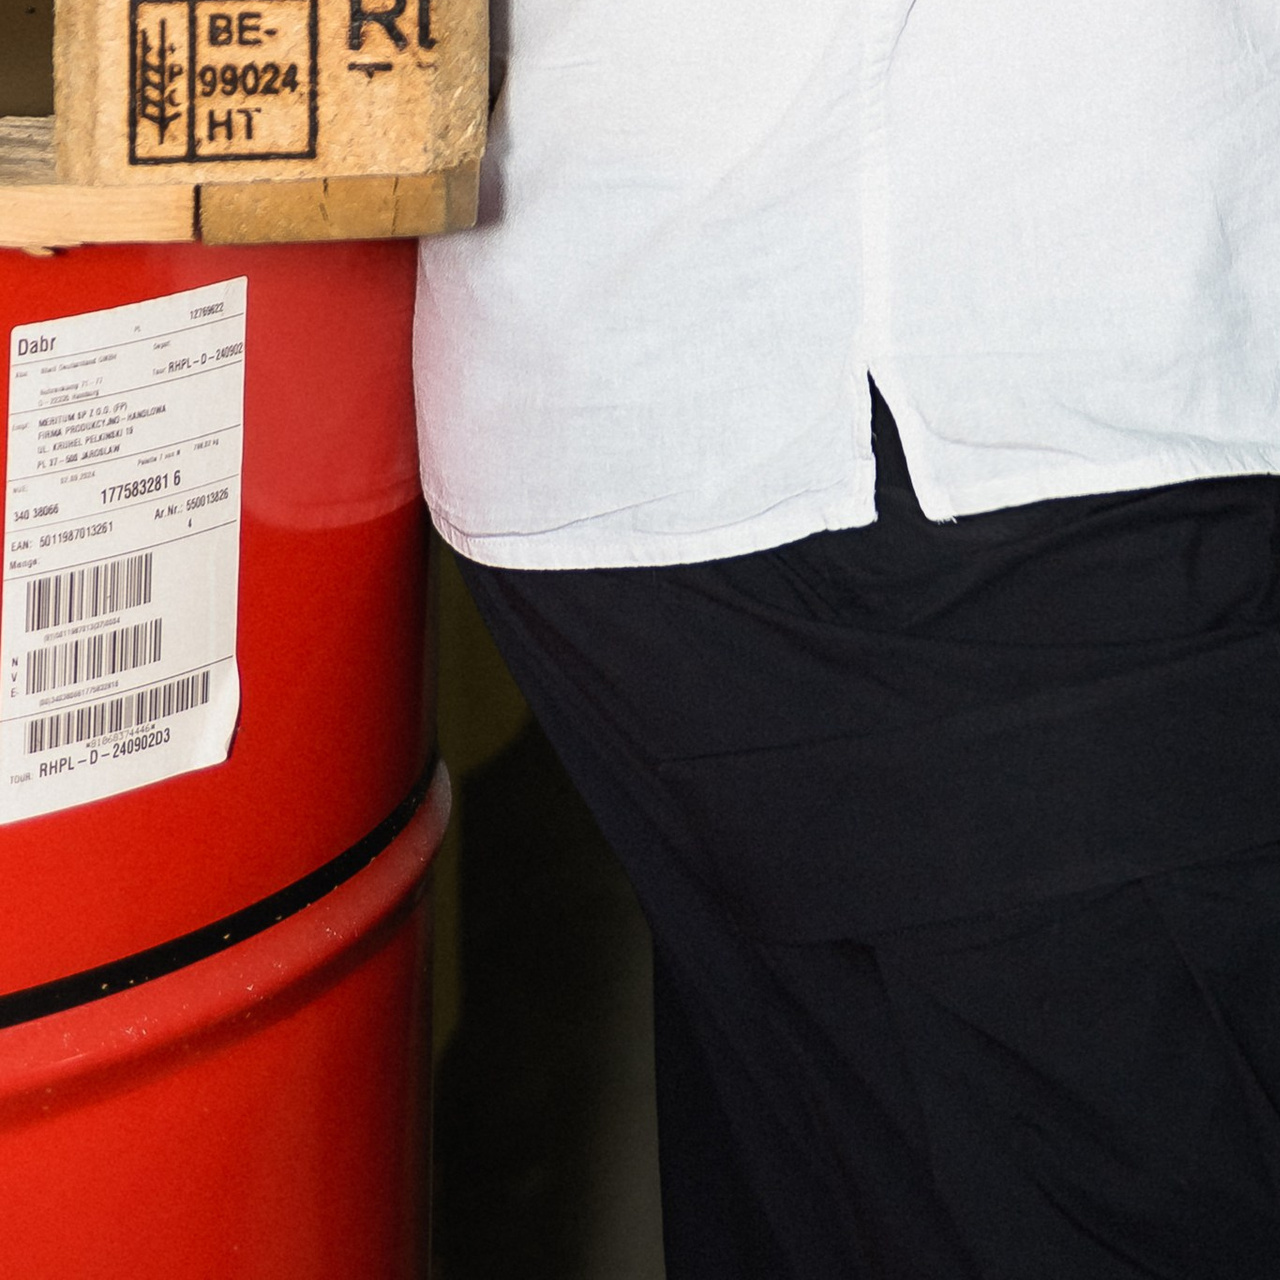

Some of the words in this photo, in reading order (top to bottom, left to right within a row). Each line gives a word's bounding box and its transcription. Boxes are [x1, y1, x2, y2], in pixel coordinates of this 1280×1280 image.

[208, 11, 278, 47] BE-
[199, 59, 300, 98] 99024
[207, 106, 263, 142] HT
[18, 336, 56, 356] Dabr
[101, 473, 168, 504] 177583281
[174, 470, 180, 486] 6
